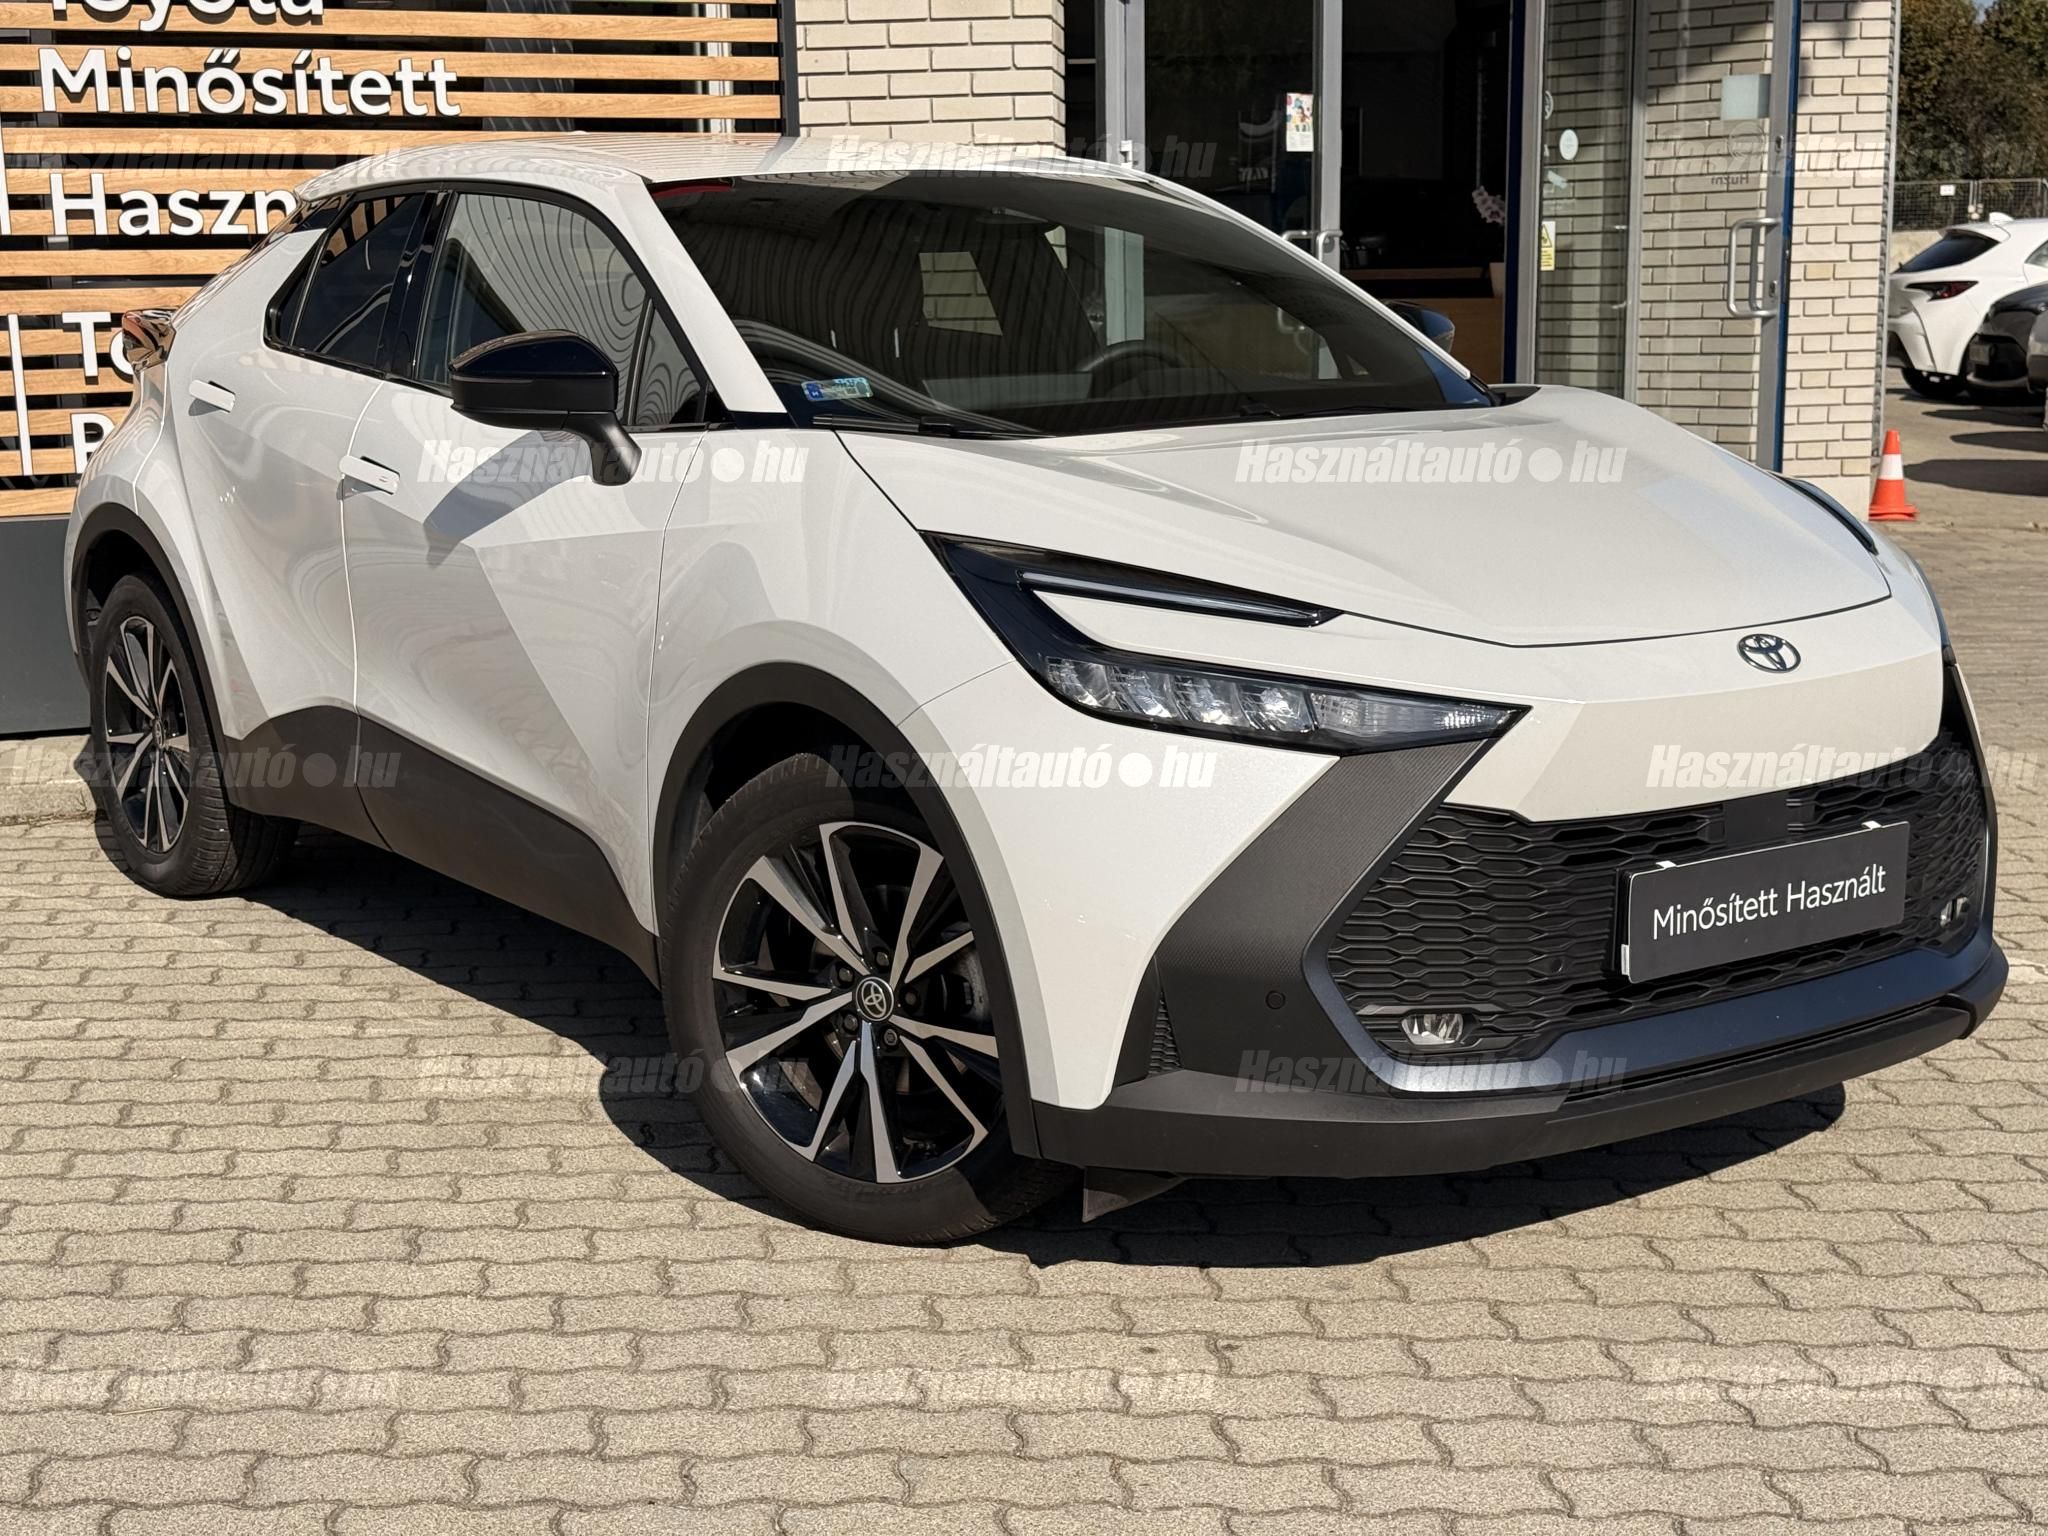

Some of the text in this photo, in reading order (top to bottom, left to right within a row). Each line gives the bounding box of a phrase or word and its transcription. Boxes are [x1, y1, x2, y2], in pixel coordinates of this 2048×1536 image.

[38, 46, 462, 116] Minősített
[49, 172, 300, 237] Haszn
[1653, 863, 1887, 941] Minősített Használt
